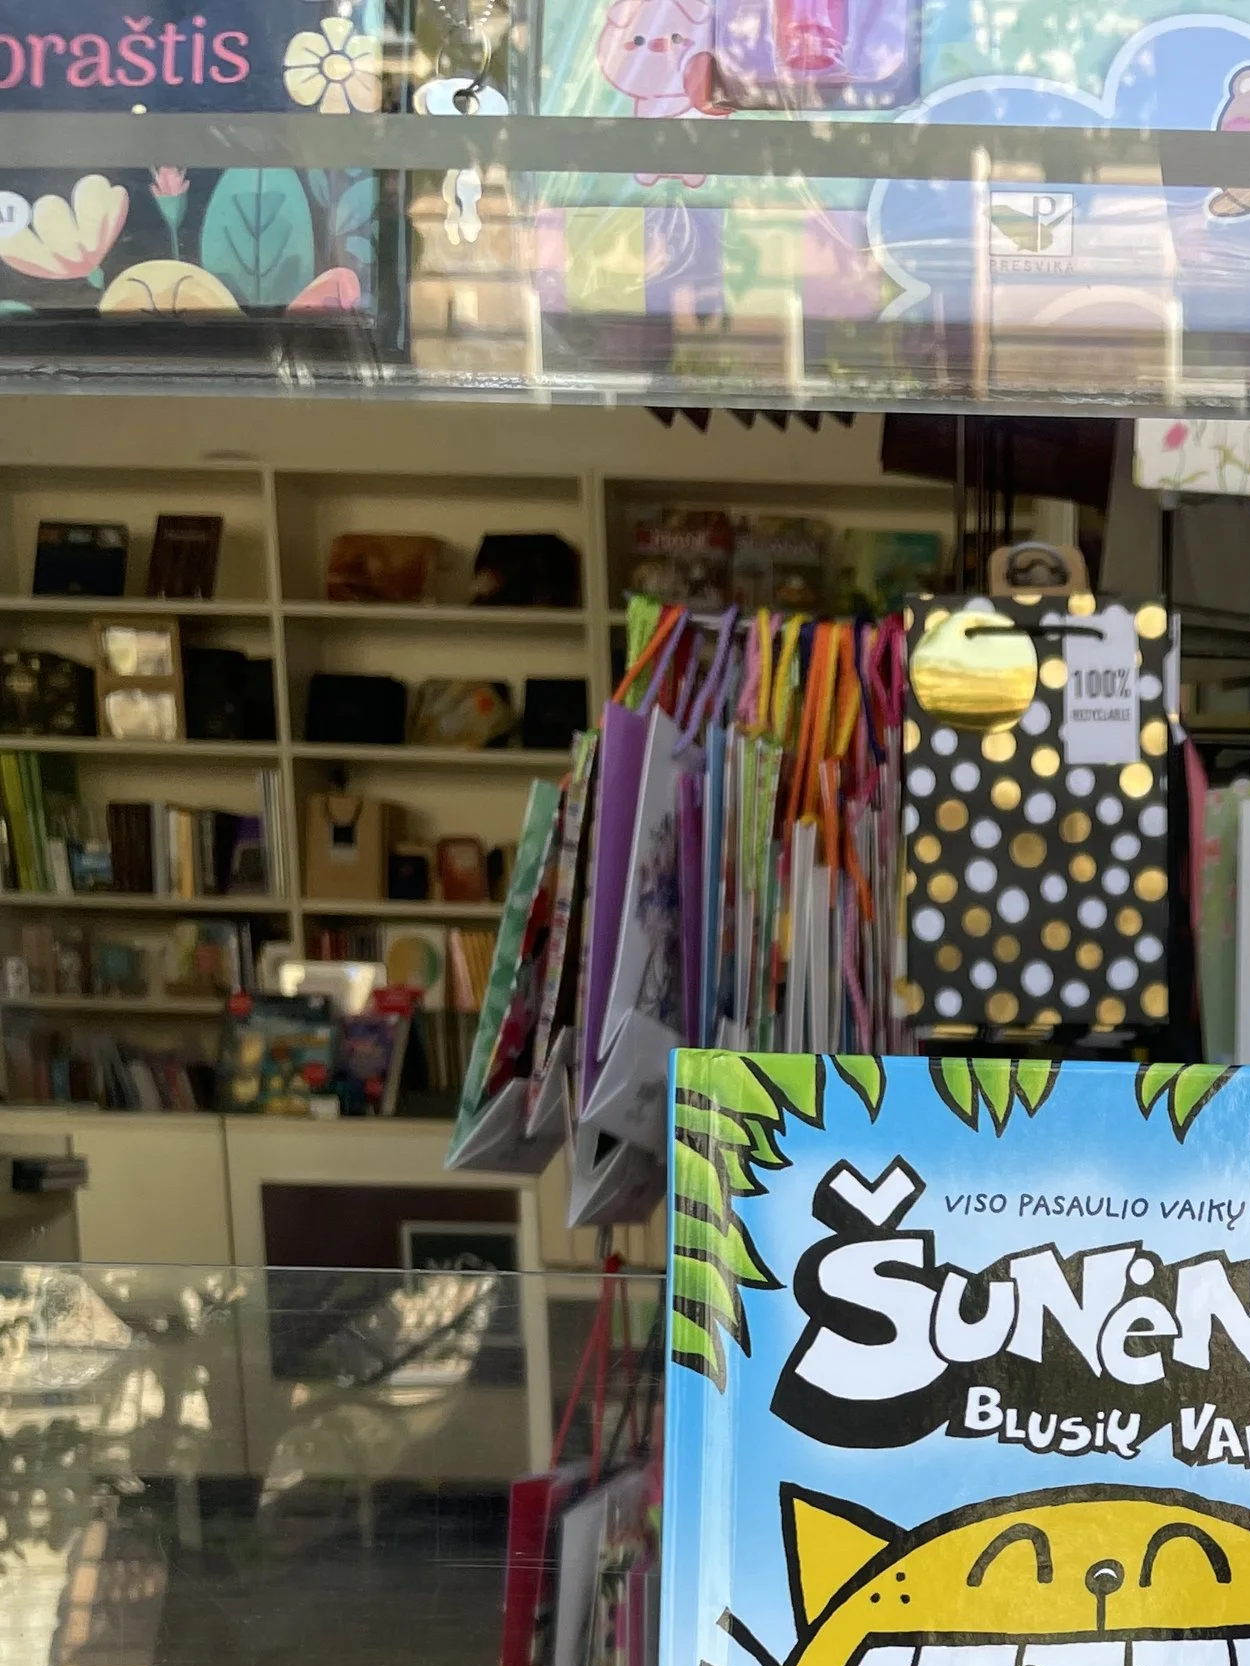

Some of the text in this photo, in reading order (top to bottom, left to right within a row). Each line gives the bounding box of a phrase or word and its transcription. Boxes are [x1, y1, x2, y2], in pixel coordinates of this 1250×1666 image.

[1073, 668, 1132, 700] 100%
[945, 1194, 1007, 1216] VISO
[1019, 1194, 1150, 1219] PASAULIO
[1160, 1198, 1246, 1231] VAIKŲ
